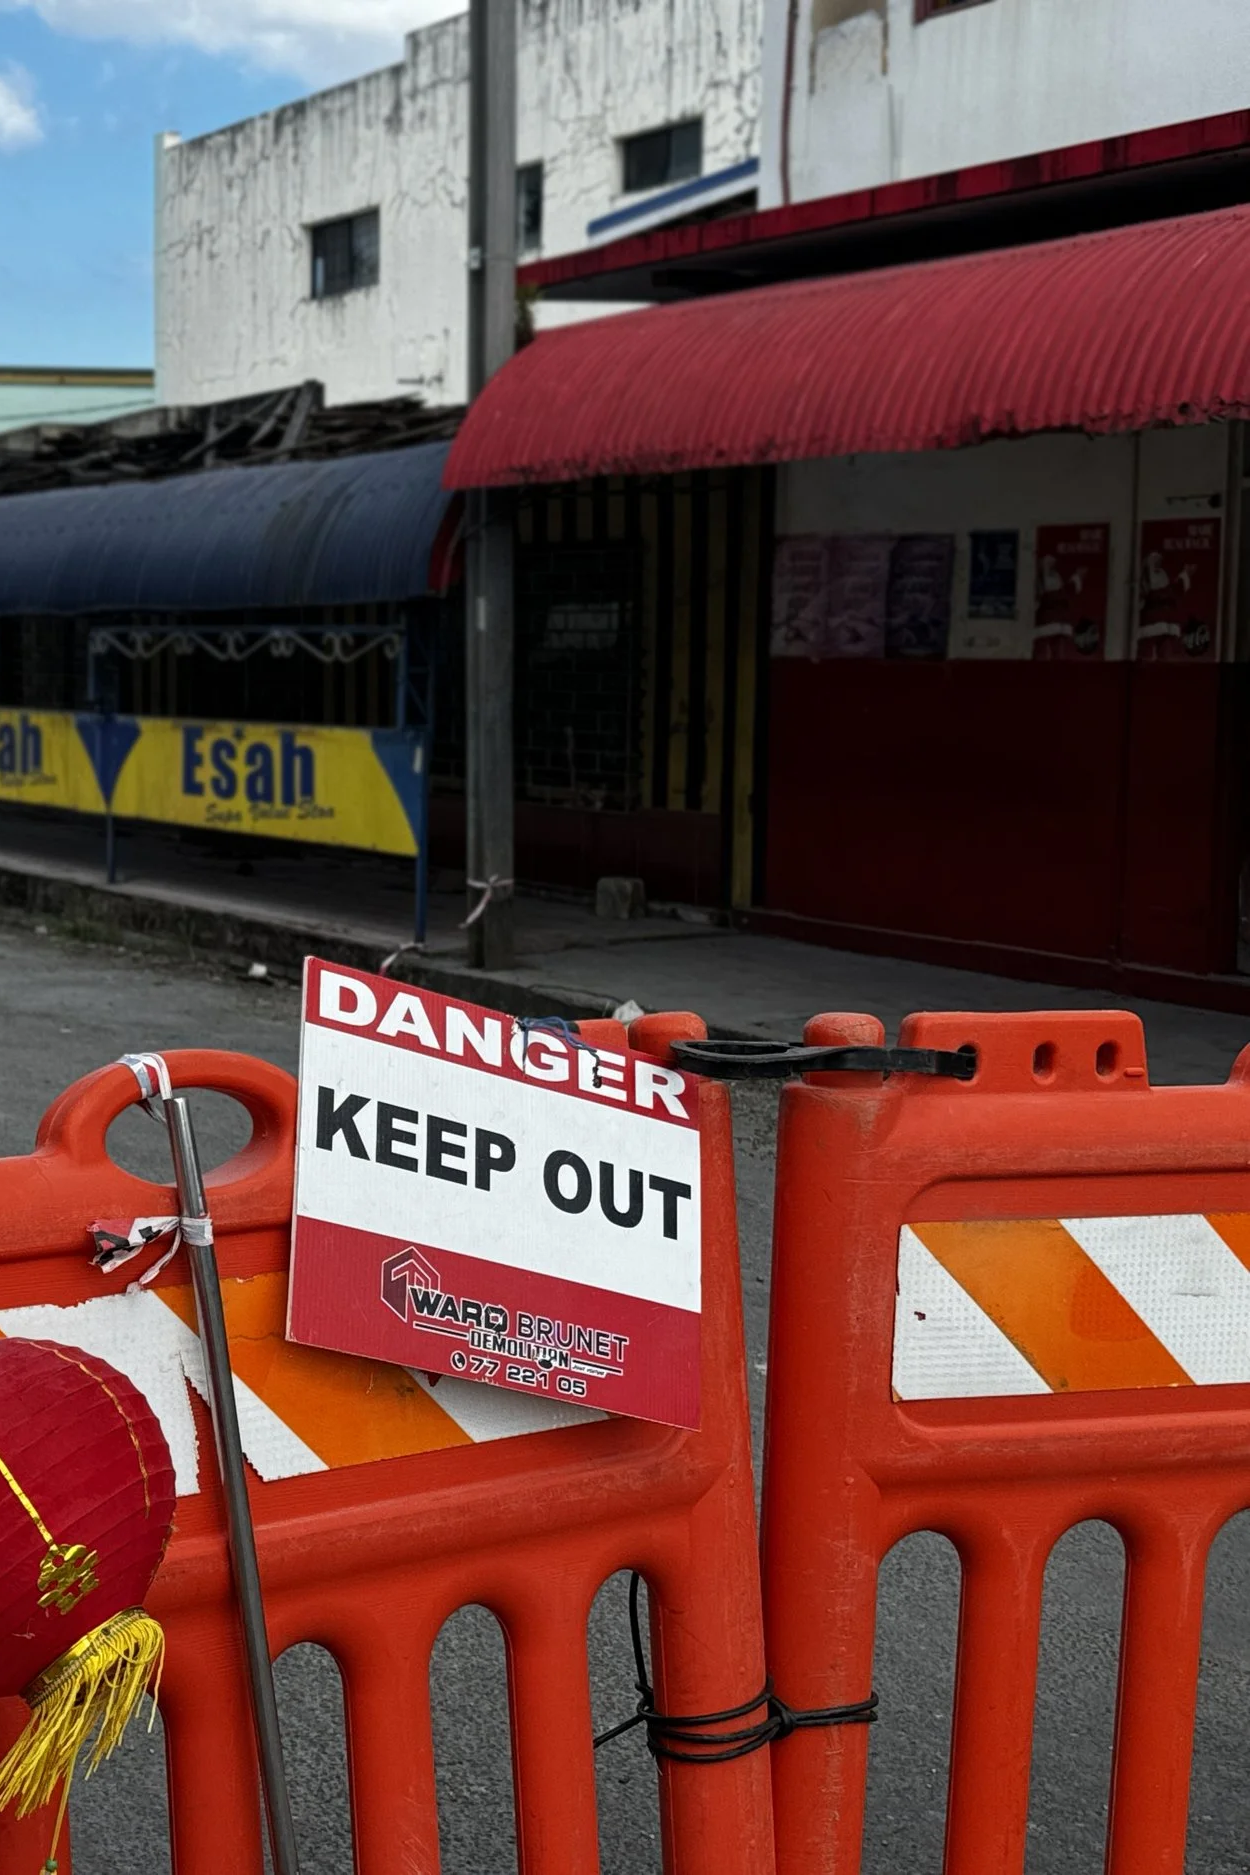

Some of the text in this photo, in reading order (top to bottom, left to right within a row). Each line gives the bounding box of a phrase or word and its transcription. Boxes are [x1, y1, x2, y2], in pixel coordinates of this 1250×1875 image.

[318, 969, 690, 1120] DANGER
[315, 1085, 692, 1240] KEEP OUT
[470, 1356, 588, 1398] 77 221 05
[517, 1310, 629, 1361] BRUNET
